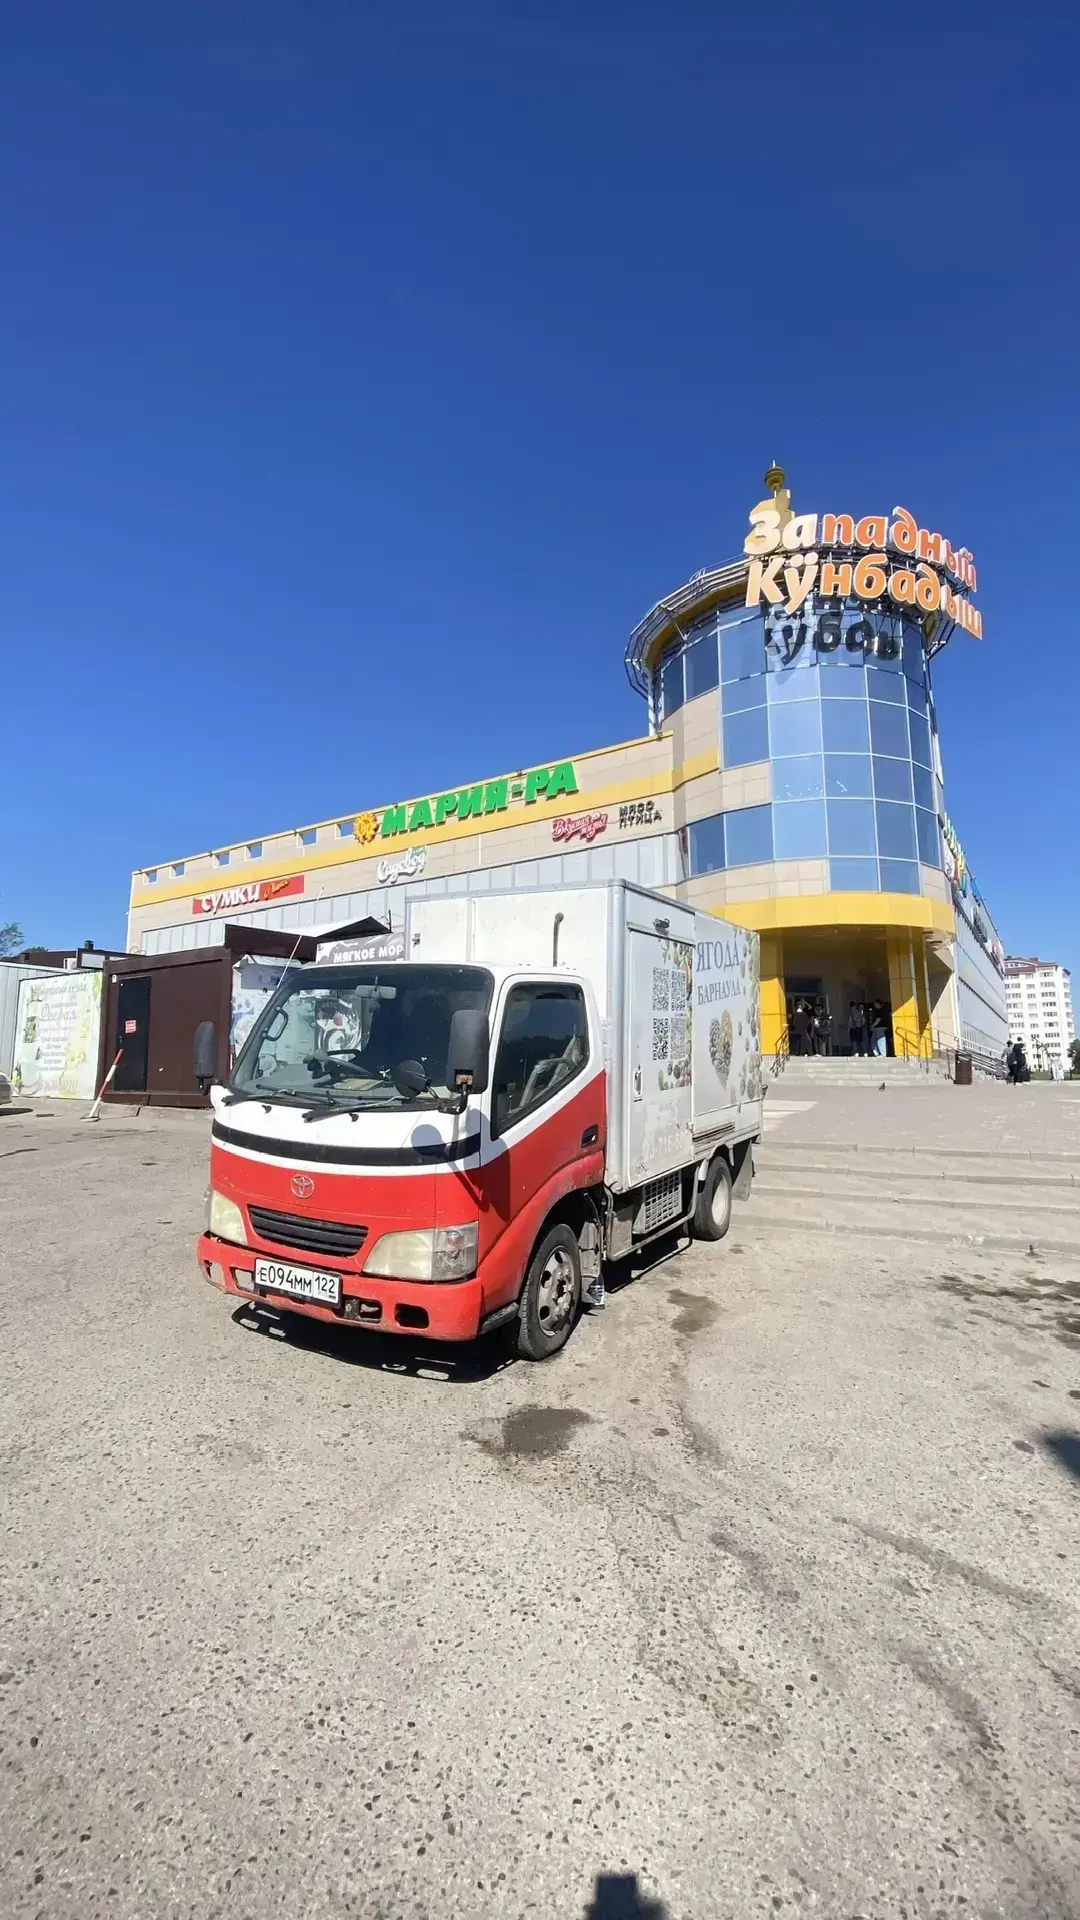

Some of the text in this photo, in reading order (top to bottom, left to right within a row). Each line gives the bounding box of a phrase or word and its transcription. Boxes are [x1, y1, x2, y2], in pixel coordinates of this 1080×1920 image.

[744, 505, 977, 593] Западный
[380, 761, 579, 837] МАРИЯ-РА
[619, 800, 655, 817] МЯСО
[619, 810, 662, 830] ПТИЦА
[201, 883, 260, 914] СУМКИ
[333, 947, 376, 963] МЯГКОЕ
[696, 940, 740, 973] ЯГОДА
[697, 979, 741, 1006] БАРНАУЛА
[260, 1265, 336, 1294] Е094ММ 122
